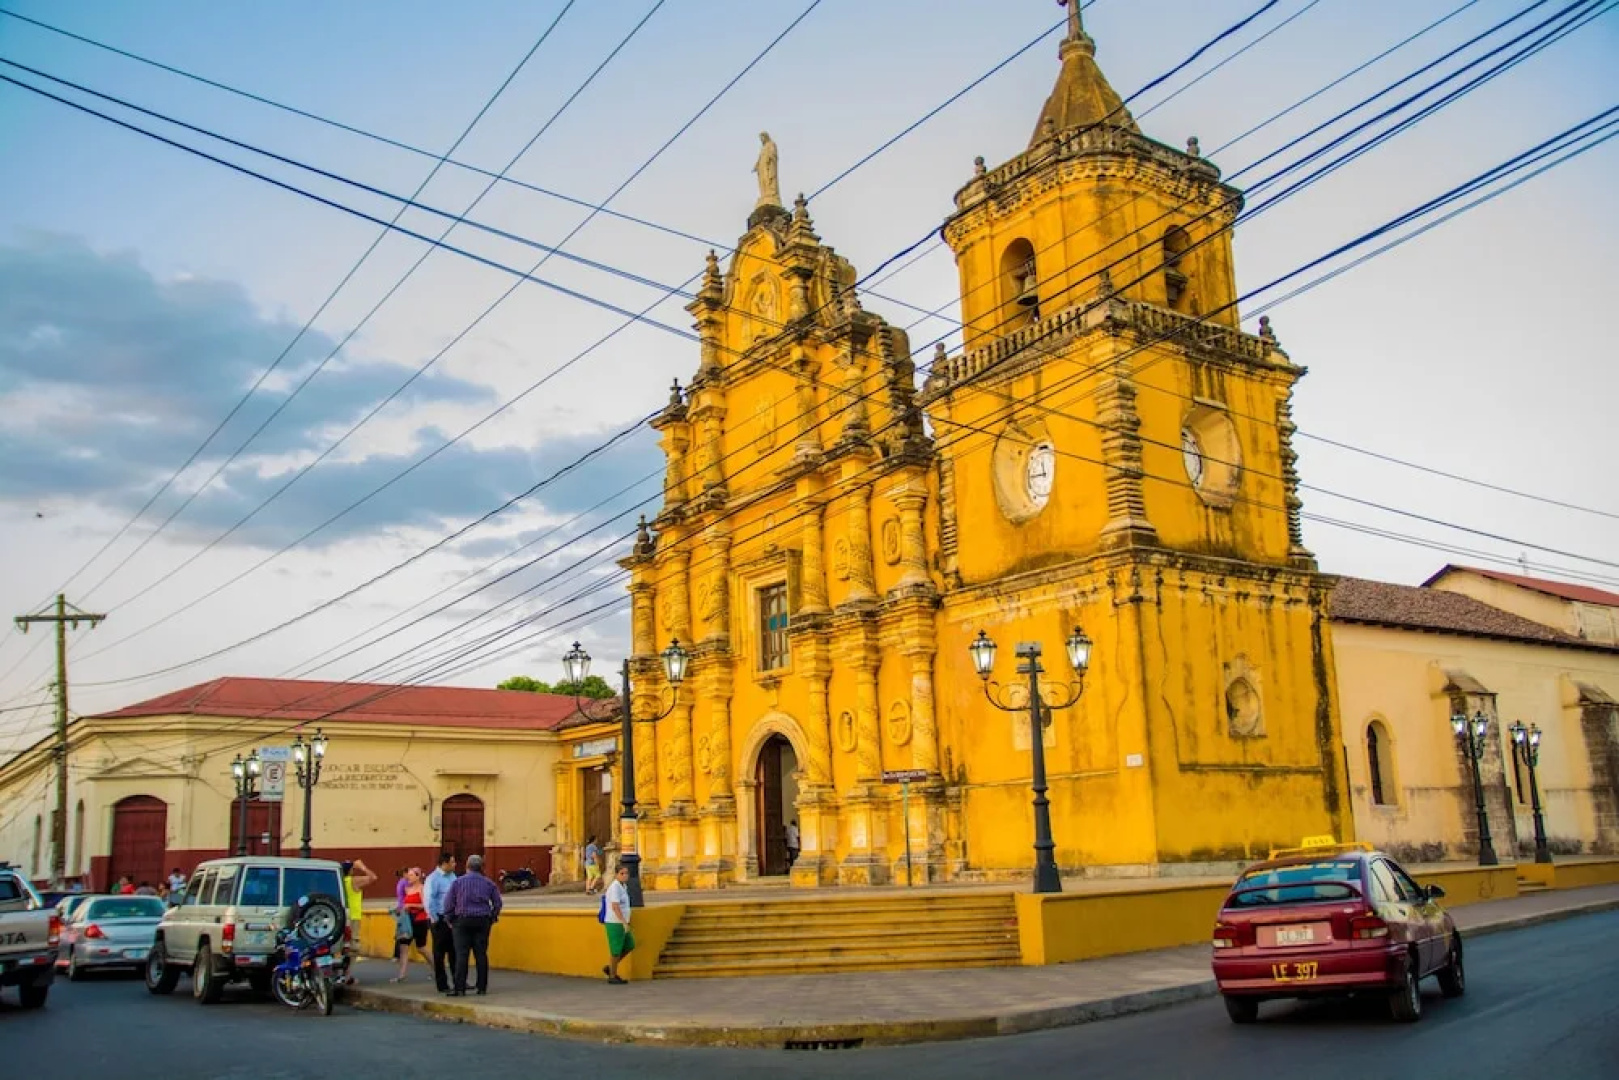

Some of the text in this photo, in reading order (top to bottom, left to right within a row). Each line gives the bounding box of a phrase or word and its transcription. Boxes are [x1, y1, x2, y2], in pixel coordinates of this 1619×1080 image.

[270, 768, 279, 780] E
[1271, 961, 1319, 982] LE 397
